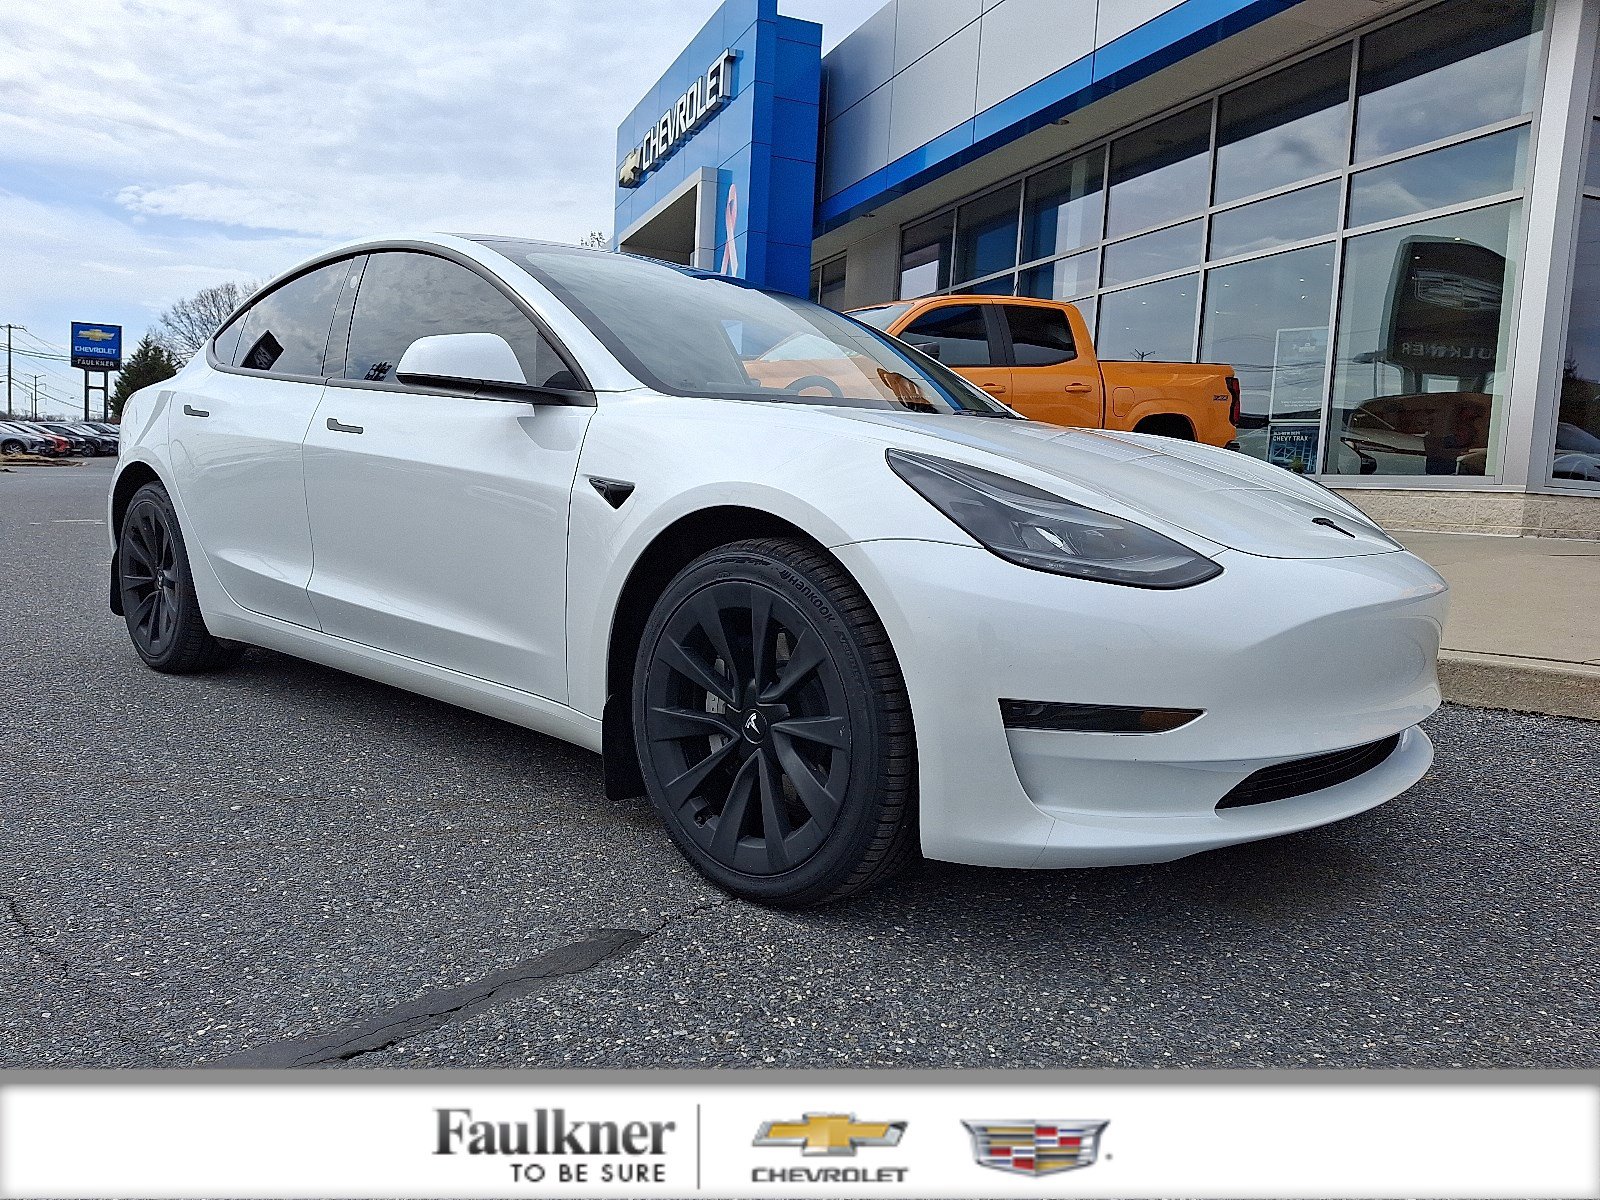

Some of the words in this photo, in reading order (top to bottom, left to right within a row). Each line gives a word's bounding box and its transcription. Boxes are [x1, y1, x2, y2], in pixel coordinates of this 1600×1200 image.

[642, 47, 733, 171] CHEVROLET
[74, 345, 116, 354] CHEVROLET
[77, 359, 114, 367] FAULKNER
